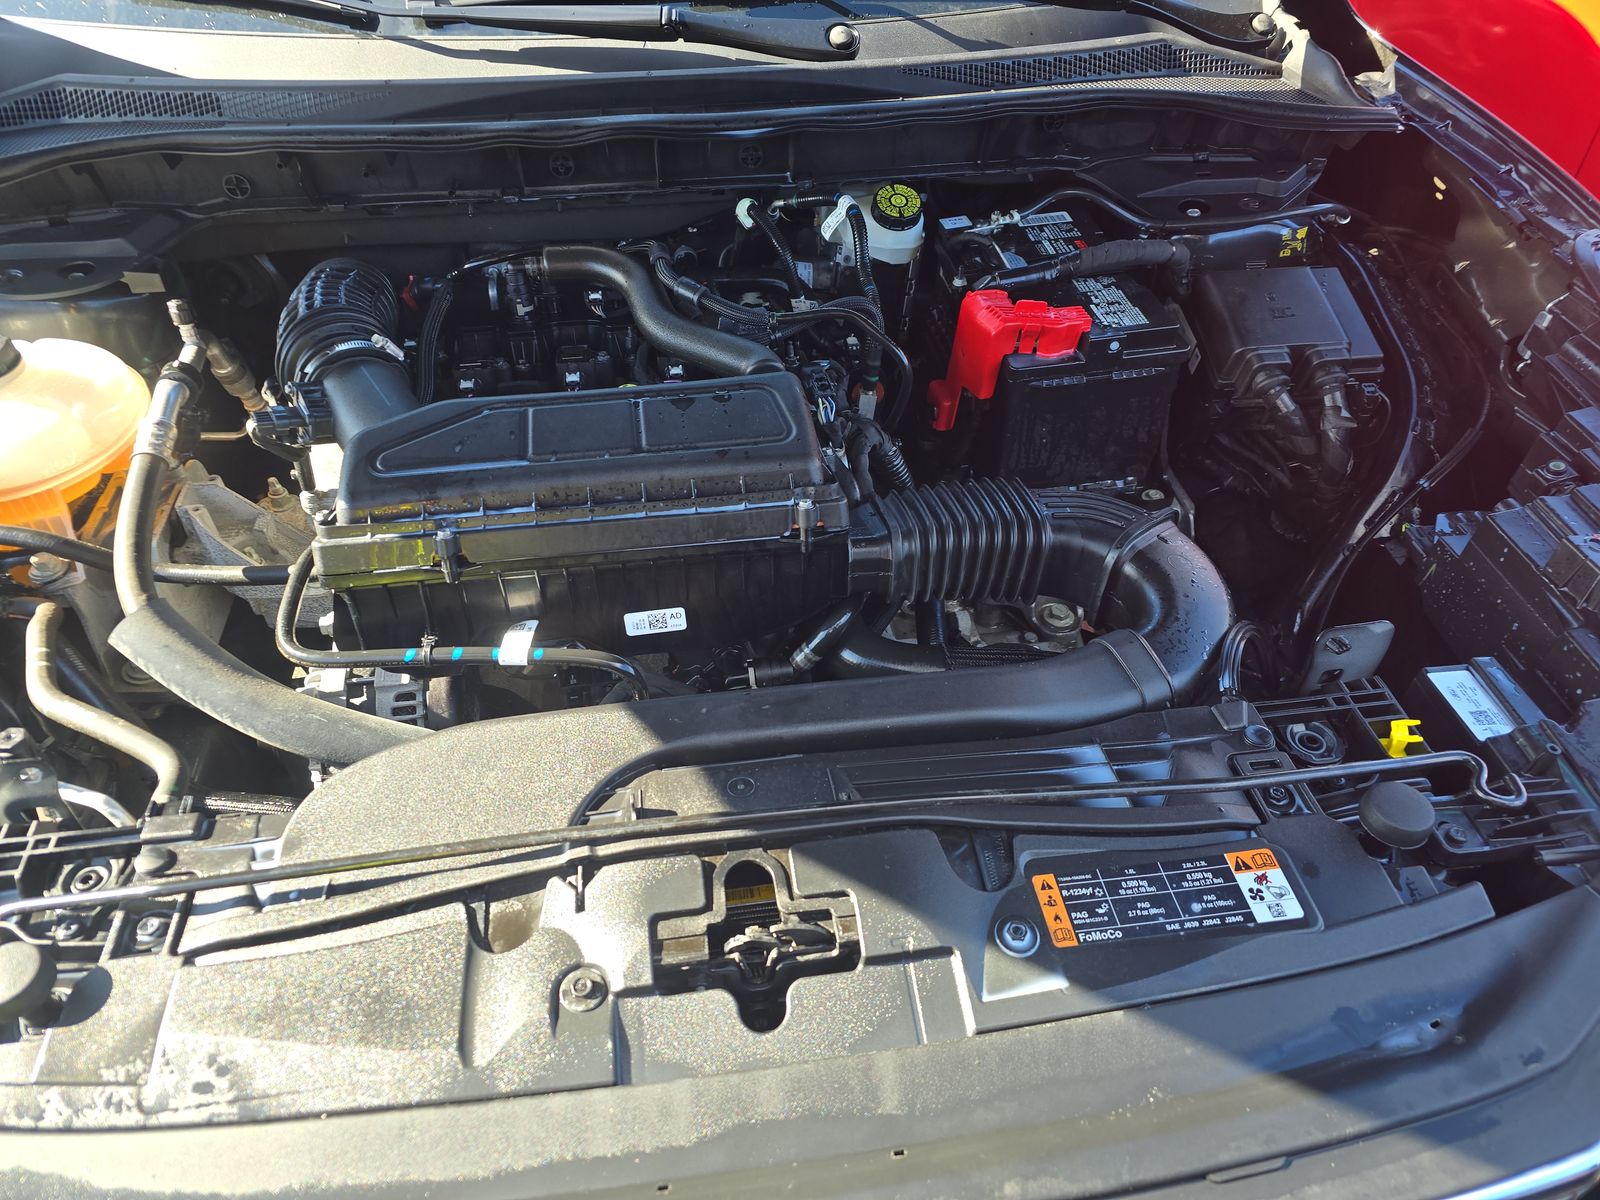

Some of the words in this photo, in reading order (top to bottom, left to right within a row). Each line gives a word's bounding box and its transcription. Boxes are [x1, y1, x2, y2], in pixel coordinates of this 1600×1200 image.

[669, 611, 683, 620] AD
[1186, 872, 1203, 881] 0.550
[1203, 871, 1213, 879] kg
[1121, 879, 1139, 888] 0.500
[1138, 879, 1148, 887] kg
[1200, 878, 1213, 886] (1.21
[1061, 887, 1093, 897] R-1234yf
[1202, 894, 1217, 902] PAG
[1136, 901, 1151, 909] PAG
[1071, 911, 1089, 919] PAG
[1165, 922, 1181, 931] SAE
[1183, 921, 1199, 929] J639
[1202, 918, 1221, 926] J2842
[1224, 915, 1244, 924] J2845
[1078, 929, 1123, 943] FoMoCo
